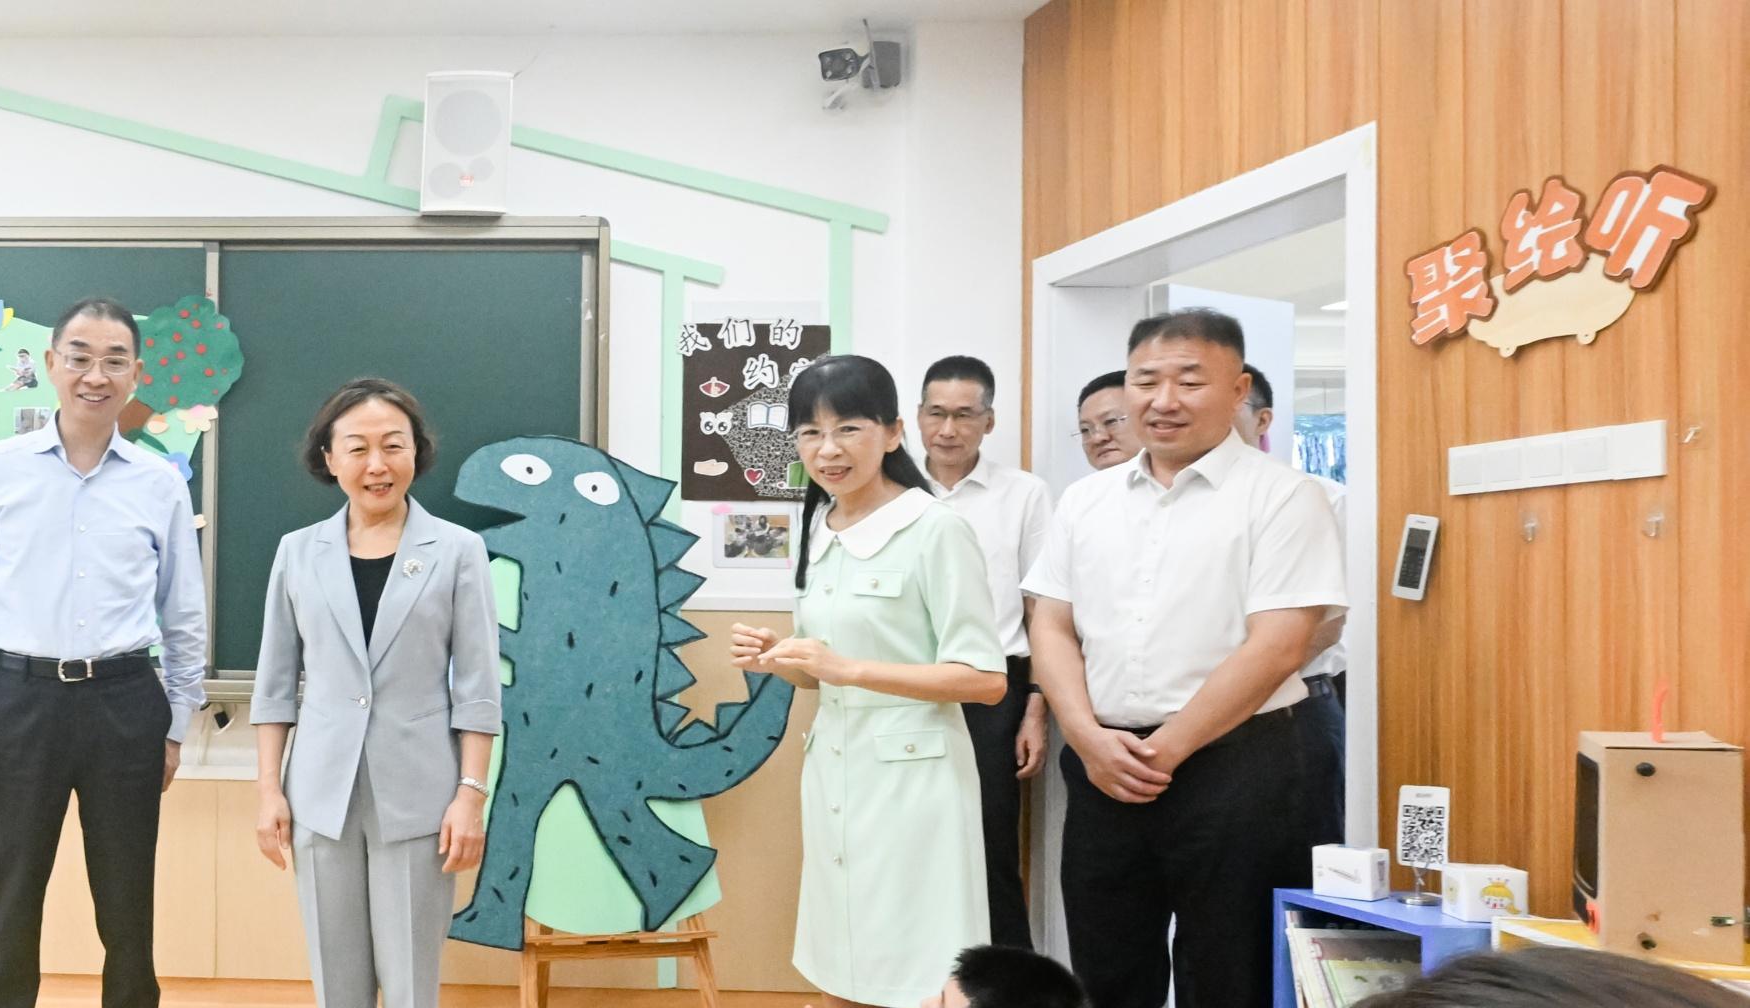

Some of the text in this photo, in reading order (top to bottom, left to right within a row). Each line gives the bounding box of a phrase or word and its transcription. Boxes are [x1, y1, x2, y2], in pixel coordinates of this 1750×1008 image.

[1406, 169, 1710, 346] 聚绘听
[679, 318, 802, 354] 我们的
